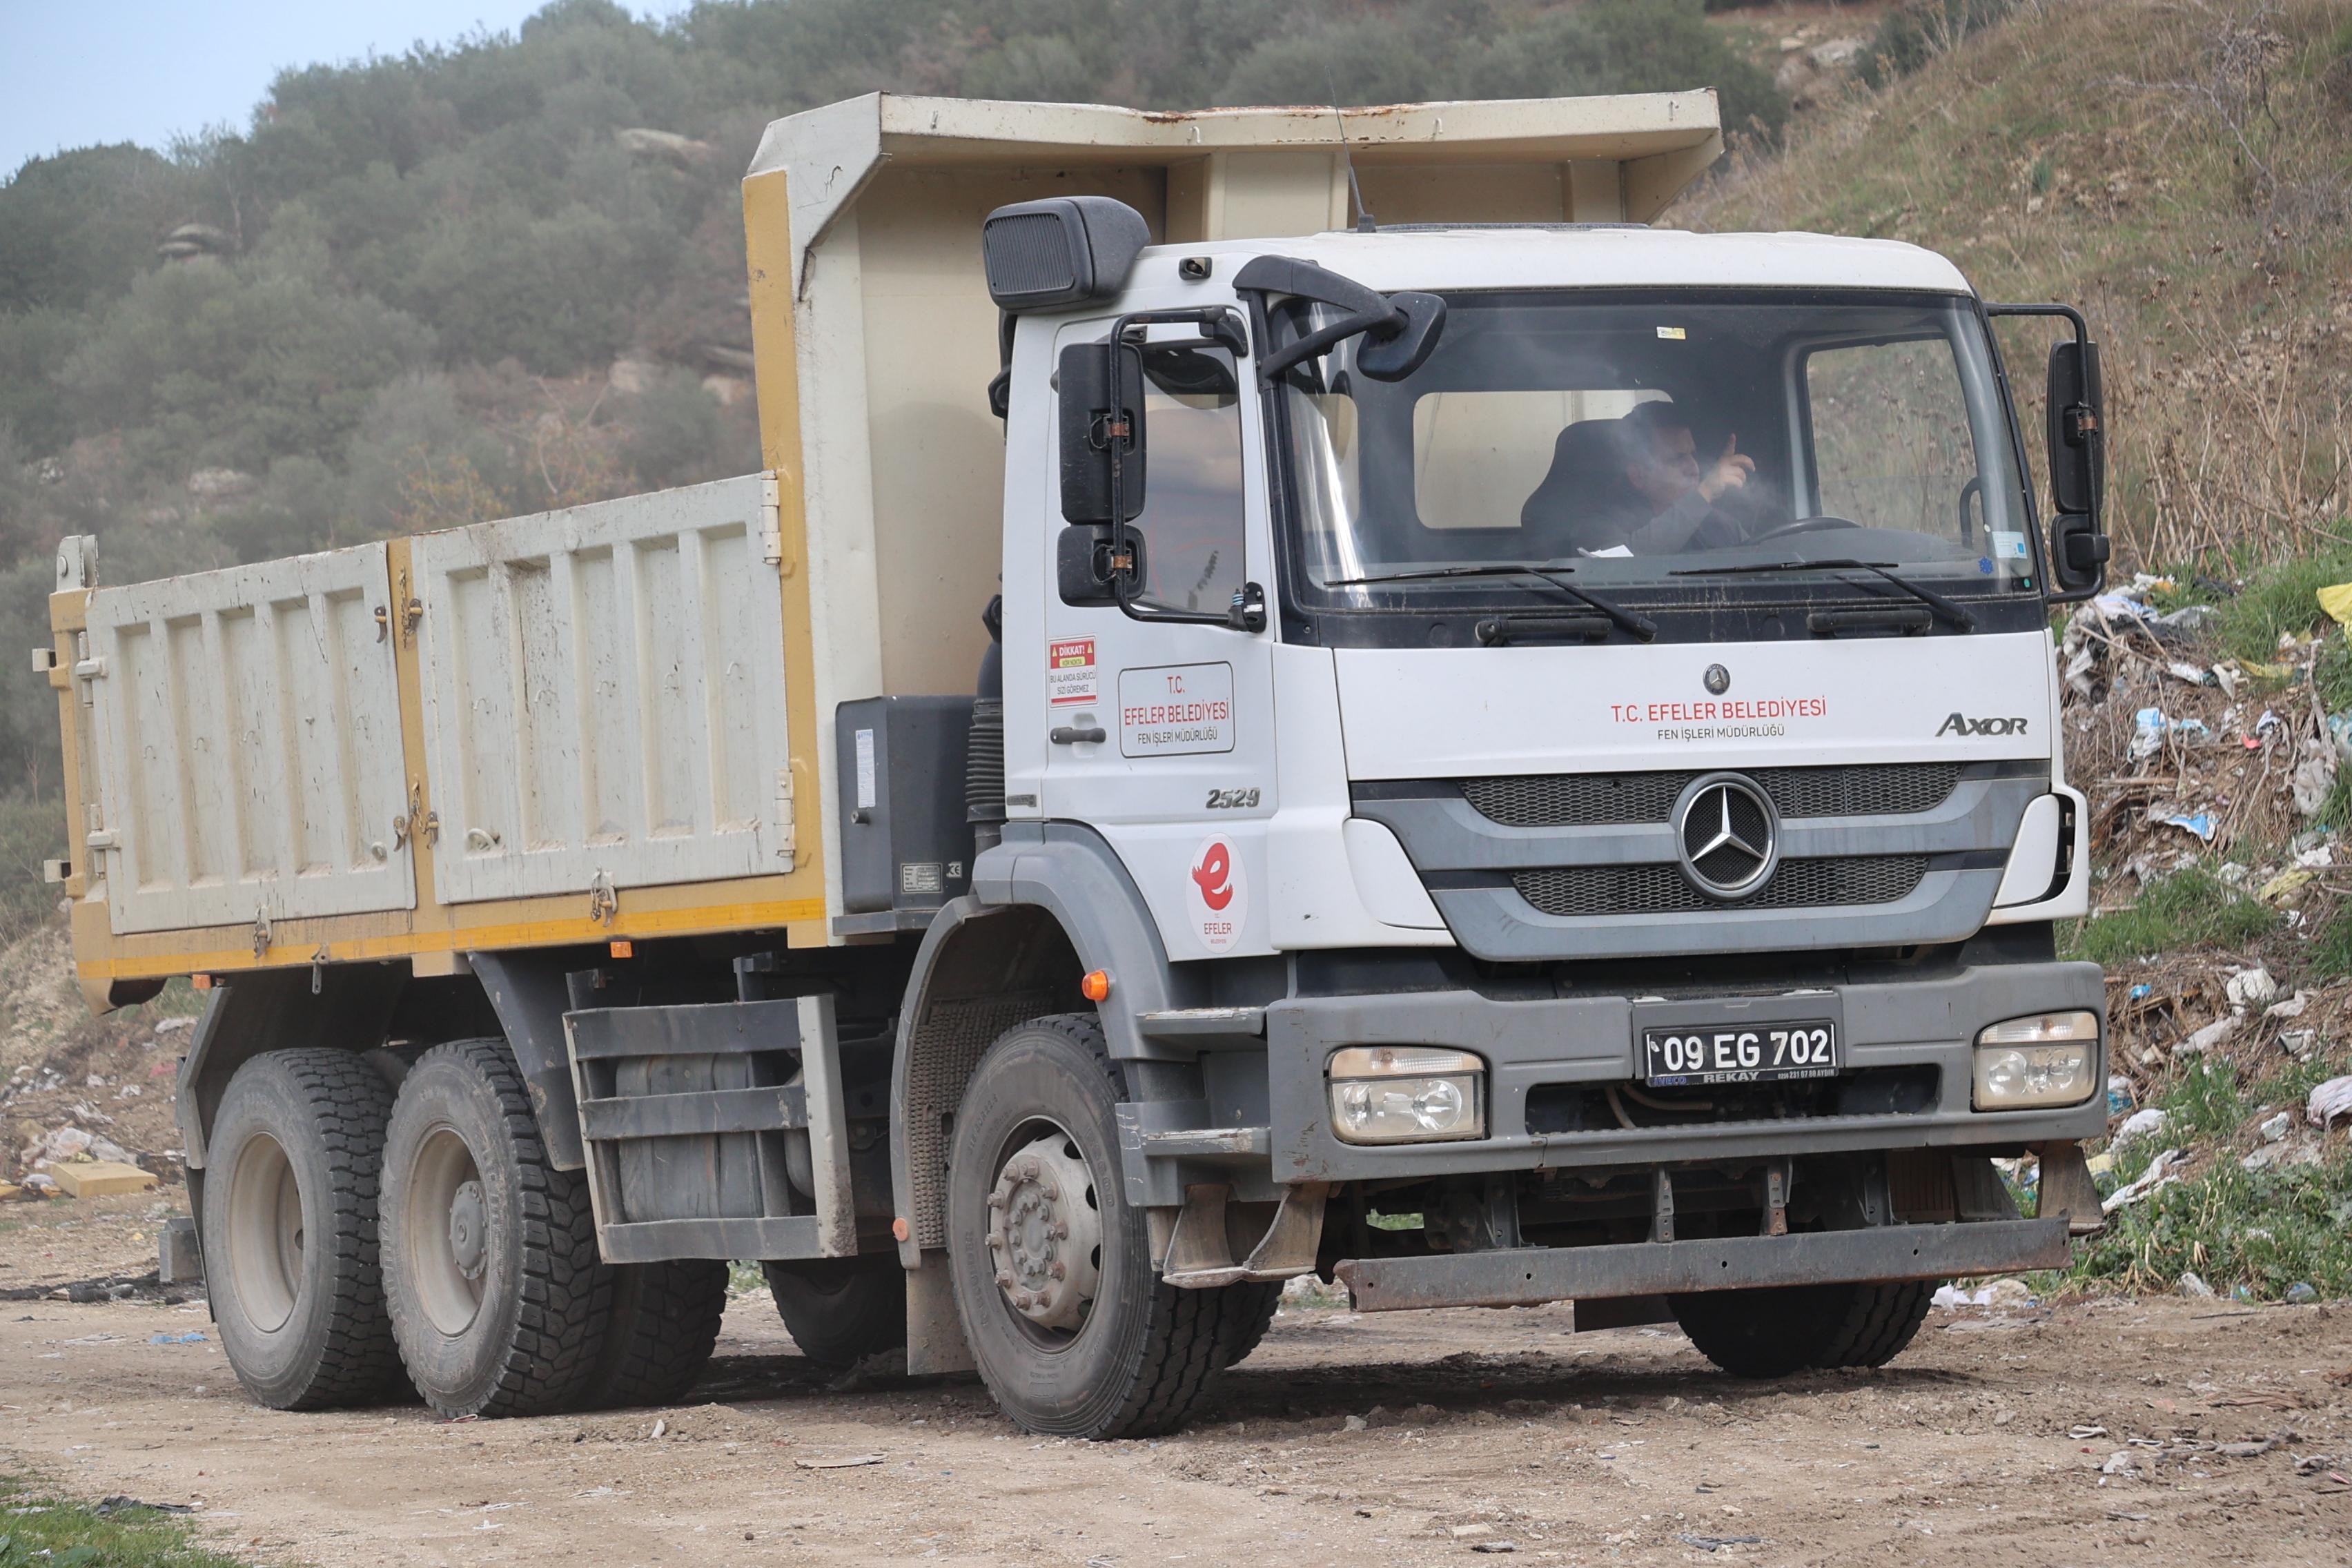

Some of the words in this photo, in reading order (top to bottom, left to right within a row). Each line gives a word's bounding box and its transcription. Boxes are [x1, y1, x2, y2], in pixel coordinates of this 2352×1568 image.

[1059, 645, 1086, 657] DİKKAT!
[1057, 672, 1076, 683] ALANDA
[1167, 676, 1185, 694] T.C.
[1067, 683, 1089, 694] GÖREMEZ
[1124, 707, 1166, 725] EFELER
[1168, 697, 1230, 723] BELEDİYESİ
[1611, 705, 1643, 723] T.C.
[1648, 703, 1716, 721] EFELER
[1722, 695, 1827, 719] BELEDİYESİ
[1137, 732, 1151, 745] FEN
[1153, 729, 1174, 747] İŞLERİ
[1175, 726, 1218, 743] MÜDÜRLÜĞÜ
[1658, 729, 1678, 740] FEN
[1681, 726, 1714, 742] İŞLERİ
[1716, 723, 1785, 738] MÜDÜRLÜĞÜ
[1206, 787, 1261, 809] 2529
[1204, 922, 1232, 934] EFELER
[1663, 1036, 1704, 1071] 09
[1714, 1033, 1760, 1068] EG
[1770, 1029, 1830, 1066] 702
[1703, 1071, 1760, 1084] REKAY
[1790, 1070, 1800, 1079] 231
